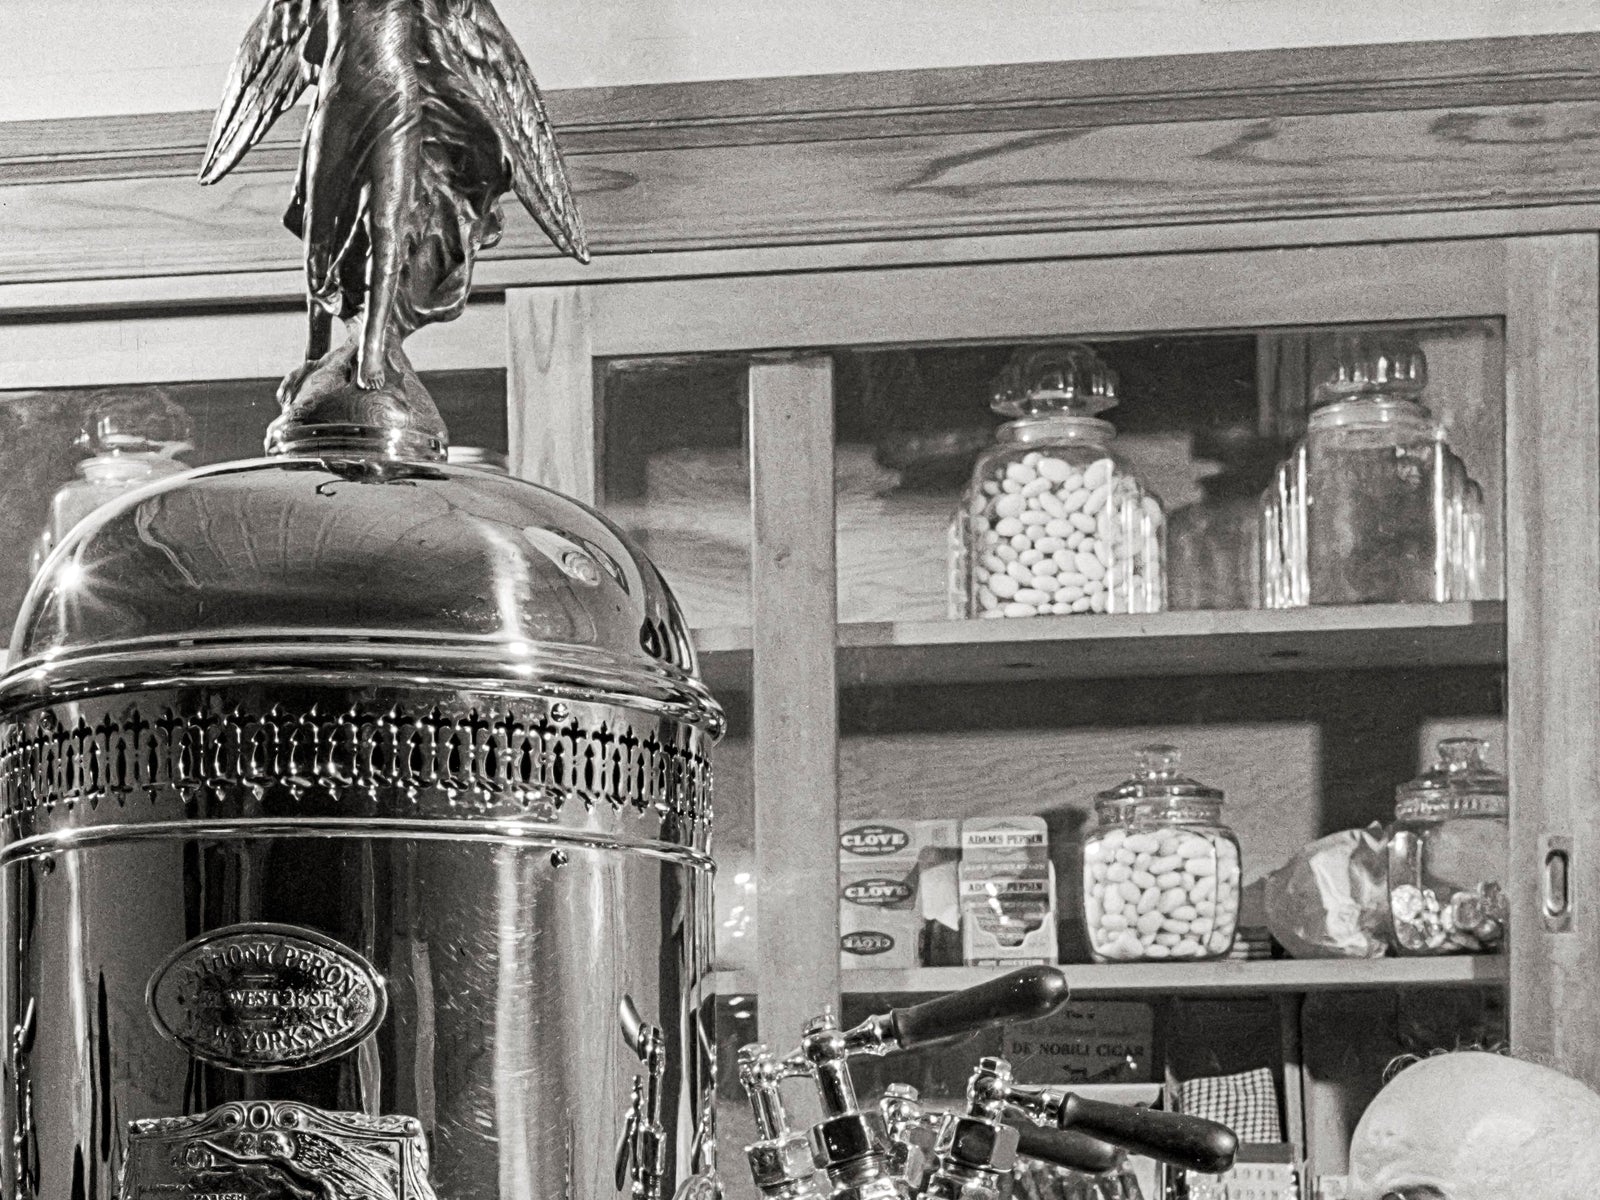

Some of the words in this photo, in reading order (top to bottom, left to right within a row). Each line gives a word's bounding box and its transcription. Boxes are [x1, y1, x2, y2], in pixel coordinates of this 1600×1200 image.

[841, 833, 905, 847] CLOVE
[968, 835, 1003, 844] ADAMS
[844, 885, 909, 898] CLOVE
[229, 989, 281, 1007] WEST
[1039, 1043, 1090, 1056] NOBILI
